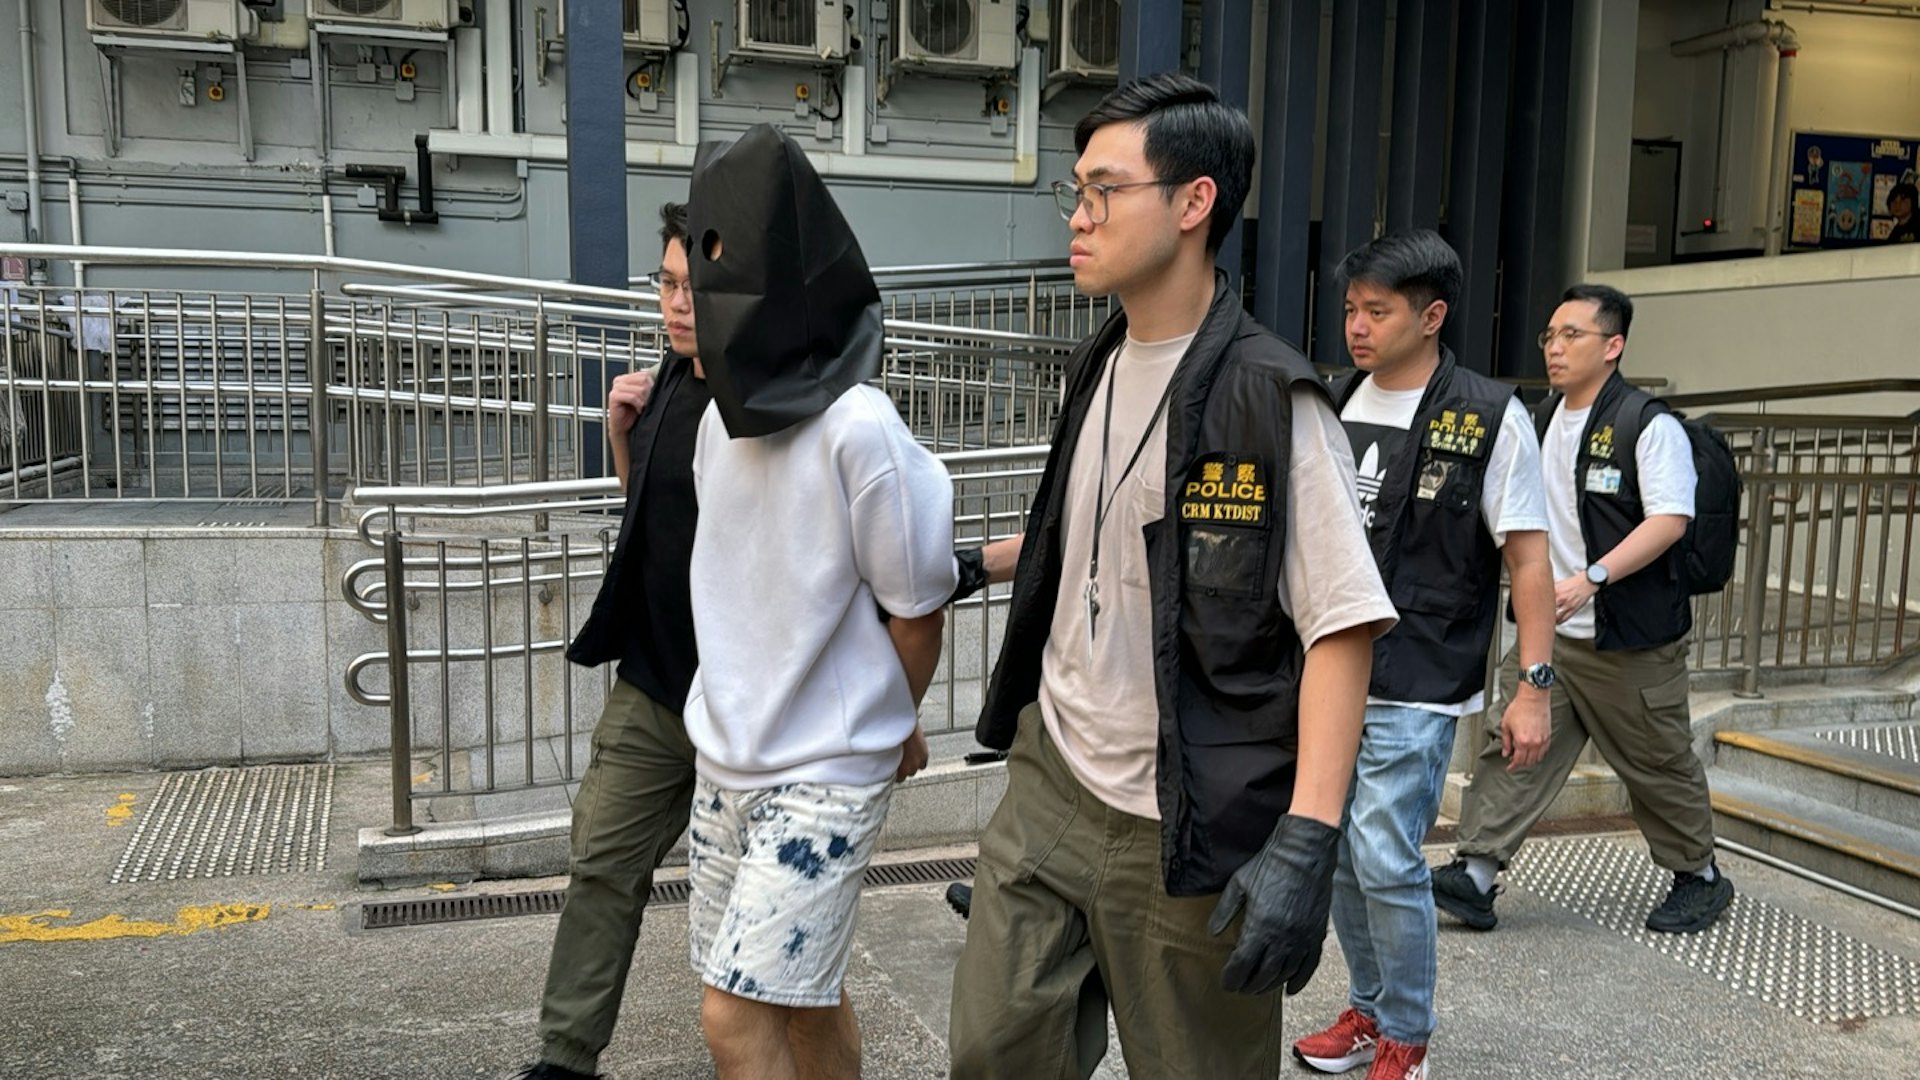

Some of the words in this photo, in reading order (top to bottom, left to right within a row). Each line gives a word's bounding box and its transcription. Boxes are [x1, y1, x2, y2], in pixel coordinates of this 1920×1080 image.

[1429, 419, 1485, 438] POLICE
[1203, 462, 1255, 483] 警察
[1186, 482, 1265, 501] POLICE
[1182, 502, 1210, 518] CRM
